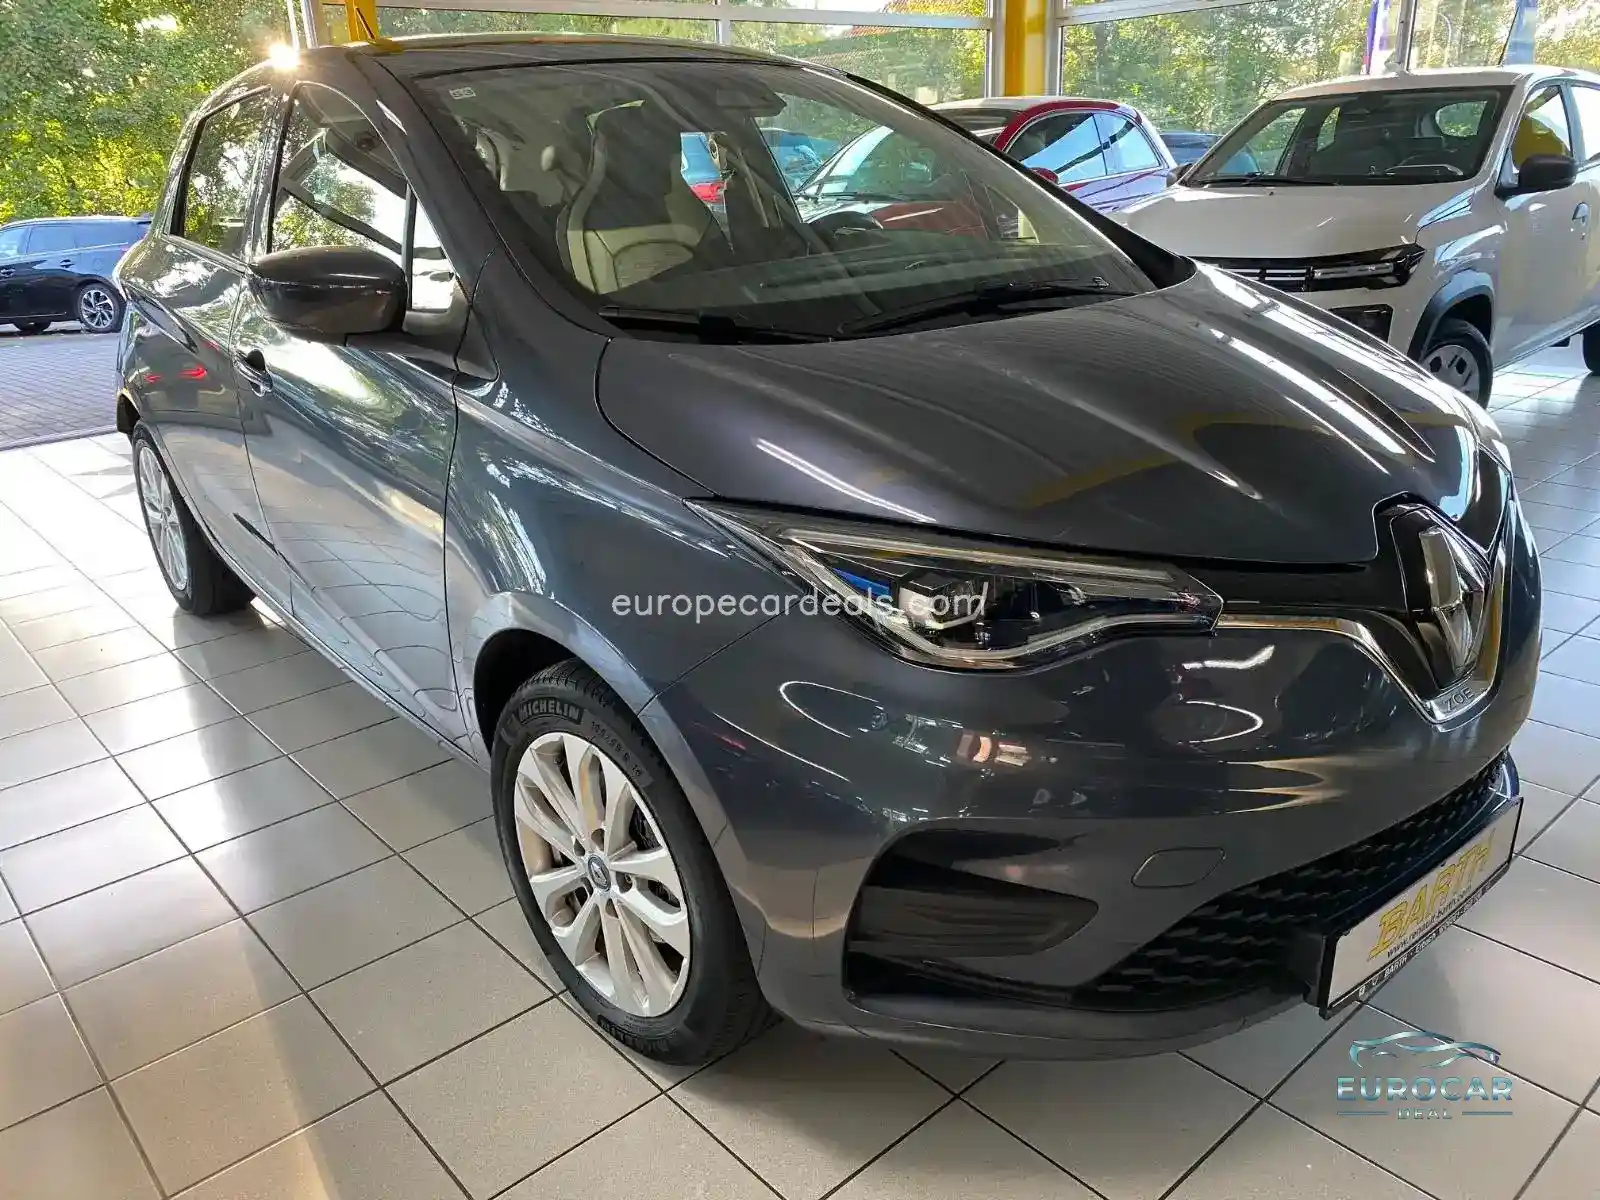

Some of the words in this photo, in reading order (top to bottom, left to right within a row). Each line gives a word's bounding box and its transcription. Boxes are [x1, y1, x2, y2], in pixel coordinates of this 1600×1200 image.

[517, 700, 581, 723] MICHELIN
[1443, 687, 1475, 712] ZOE
[1367, 828, 1496, 962] BARTH
